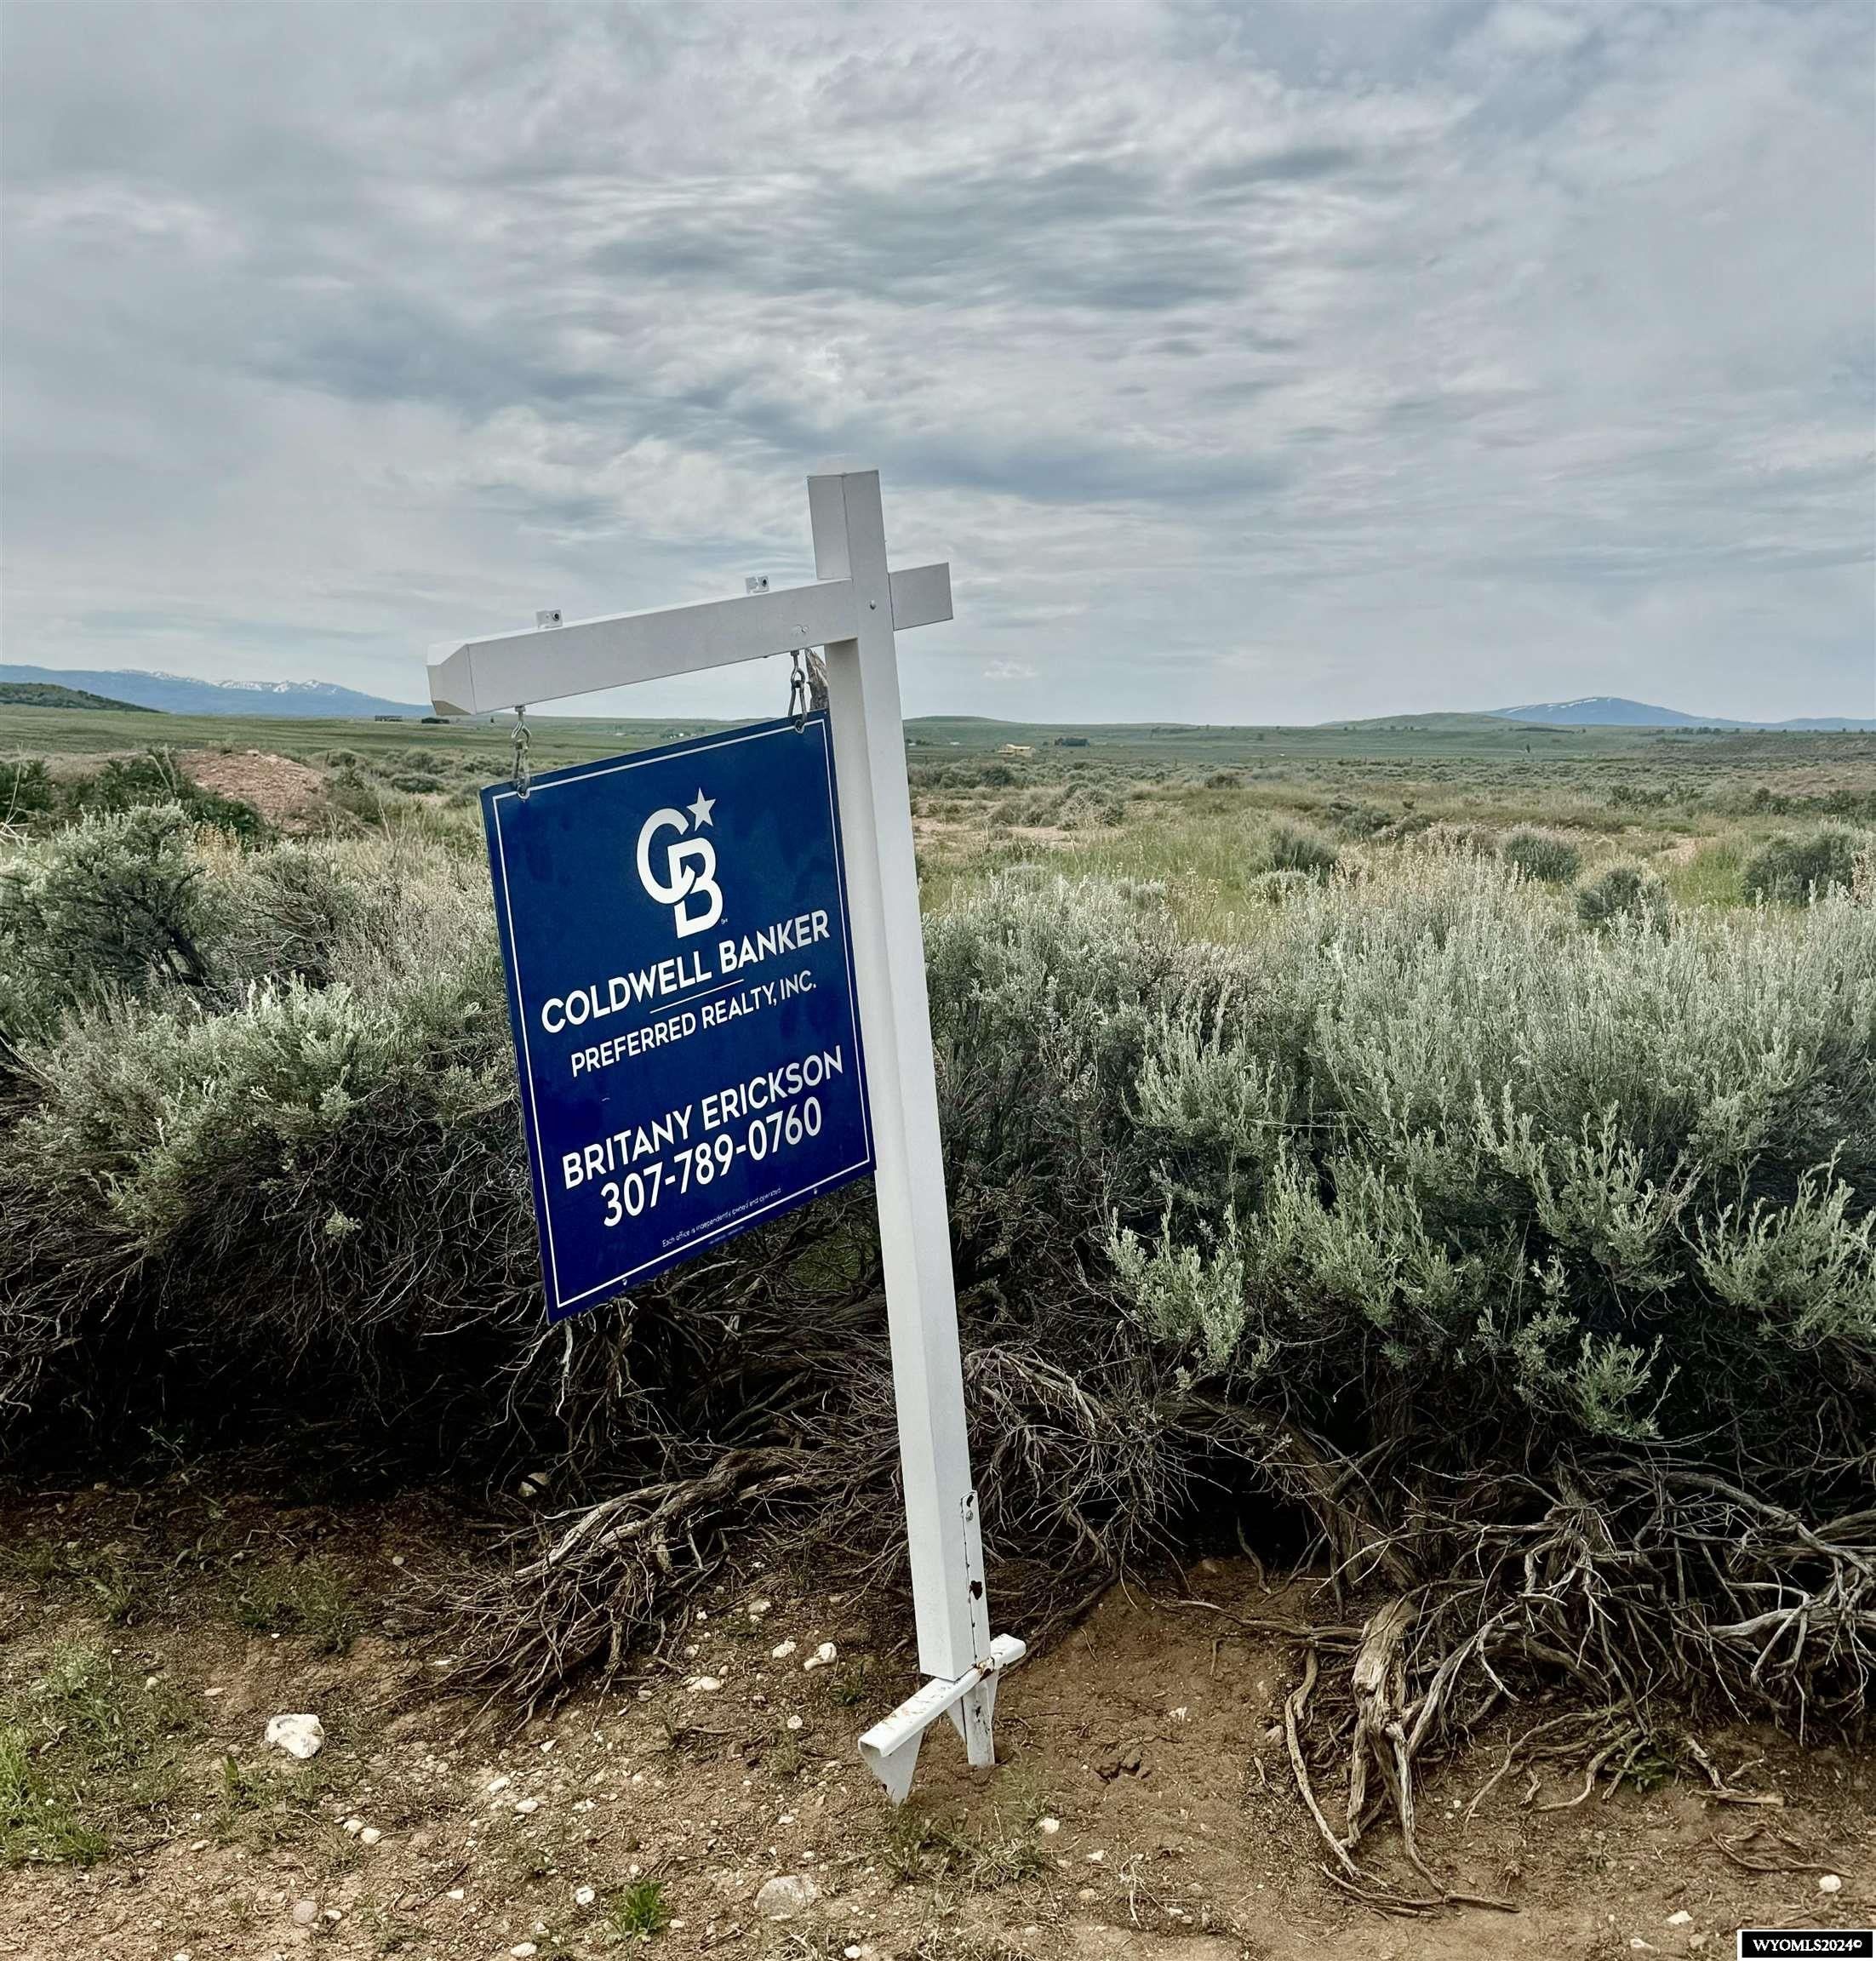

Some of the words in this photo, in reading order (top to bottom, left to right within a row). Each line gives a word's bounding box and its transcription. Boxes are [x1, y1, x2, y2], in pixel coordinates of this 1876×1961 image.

[541, 951, 712, 1033] COLDWELL
[718, 909, 831, 975] BANKER
[570, 1012, 696, 1078] PREFERRED
[701, 981, 778, 1029] REALTY,
[780, 969, 817, 1000] INC.
[562, 1104, 694, 1190] BRITANY
[701, 1044, 844, 1131] ERICKSON
[600, 1096, 821, 1227] 307-789-0760
